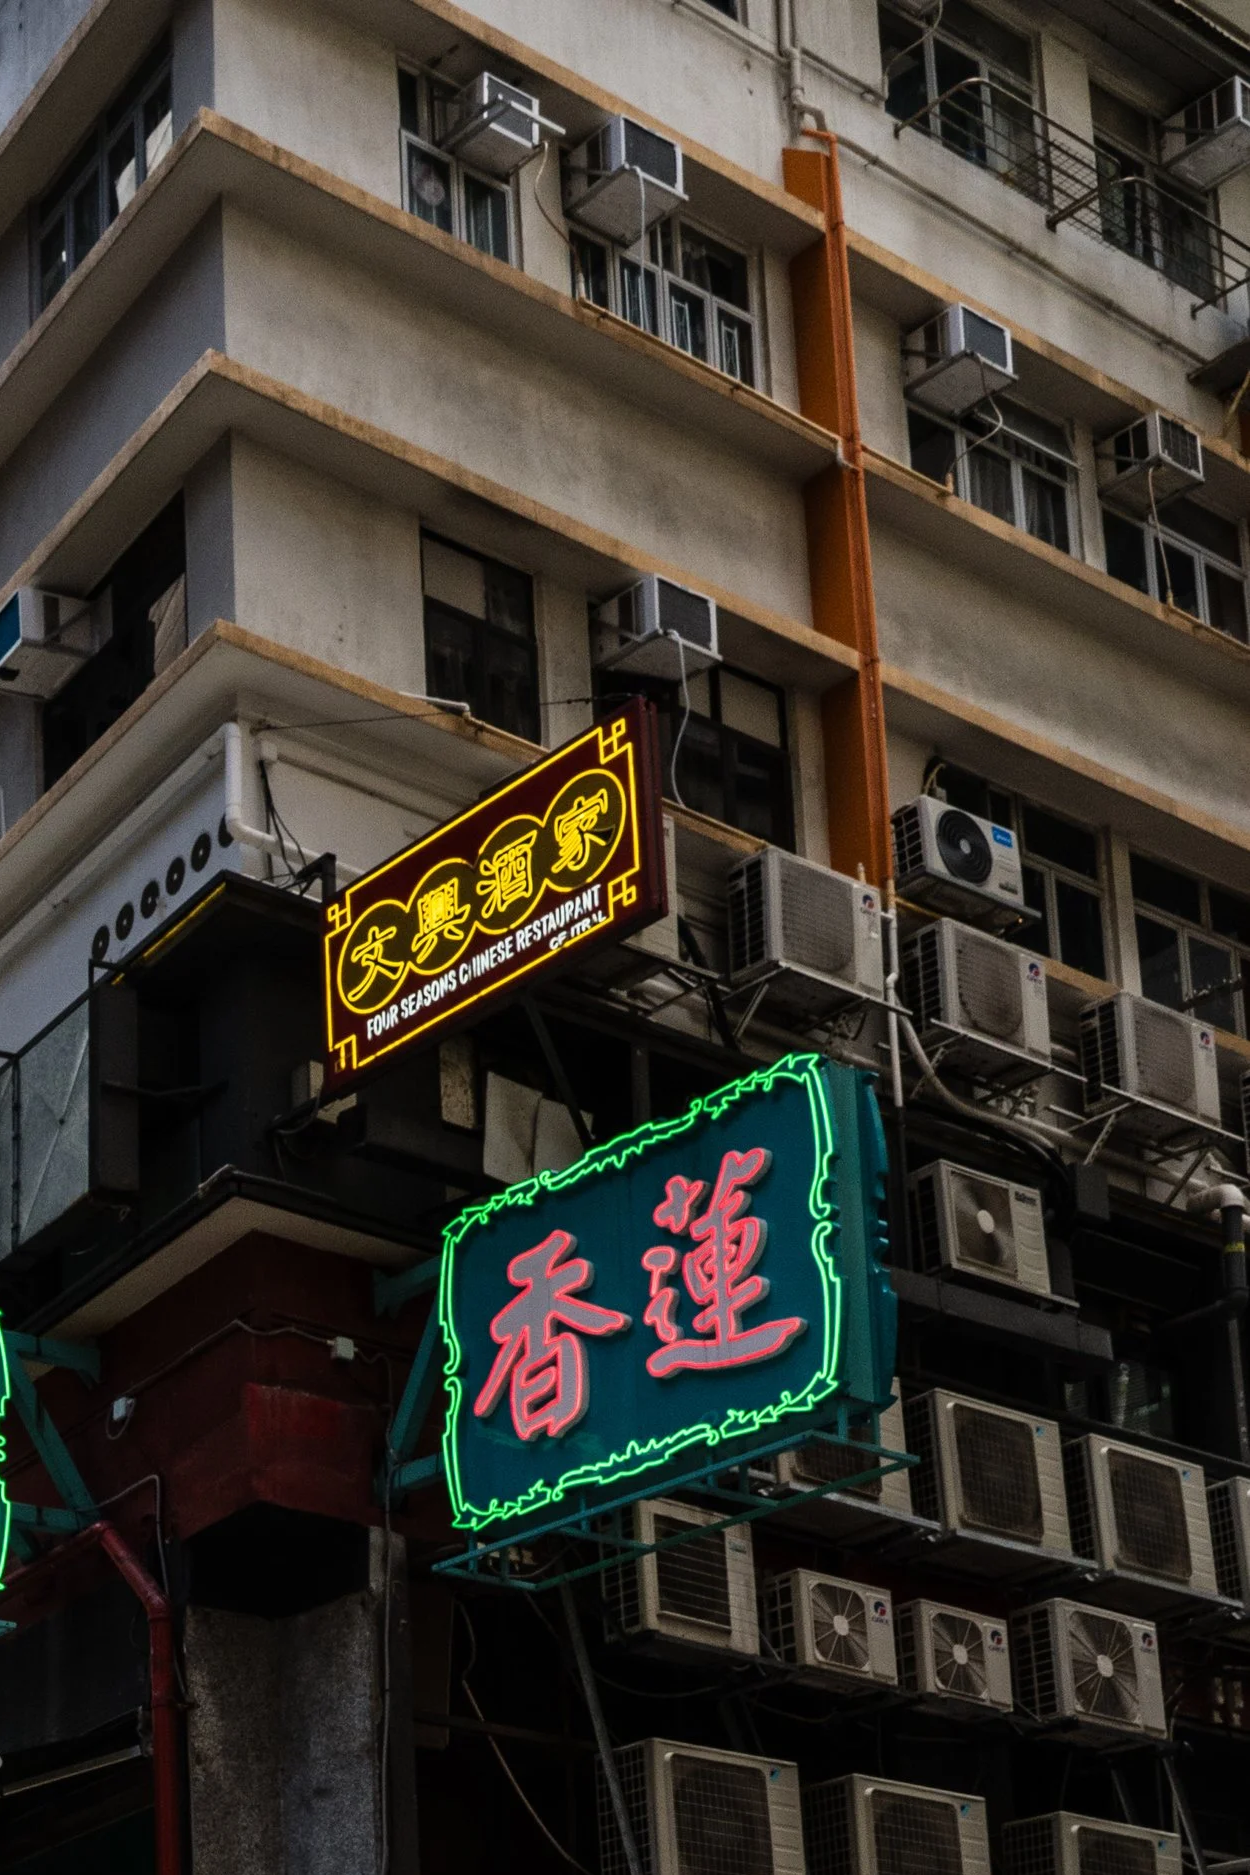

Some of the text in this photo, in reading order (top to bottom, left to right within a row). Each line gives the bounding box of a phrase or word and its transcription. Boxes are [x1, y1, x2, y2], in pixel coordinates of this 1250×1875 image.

[347, 788, 616, 1001] 文興酒家
[366, 884, 603, 1041] FOUR SEASONS CHINESE RESTAURANT
